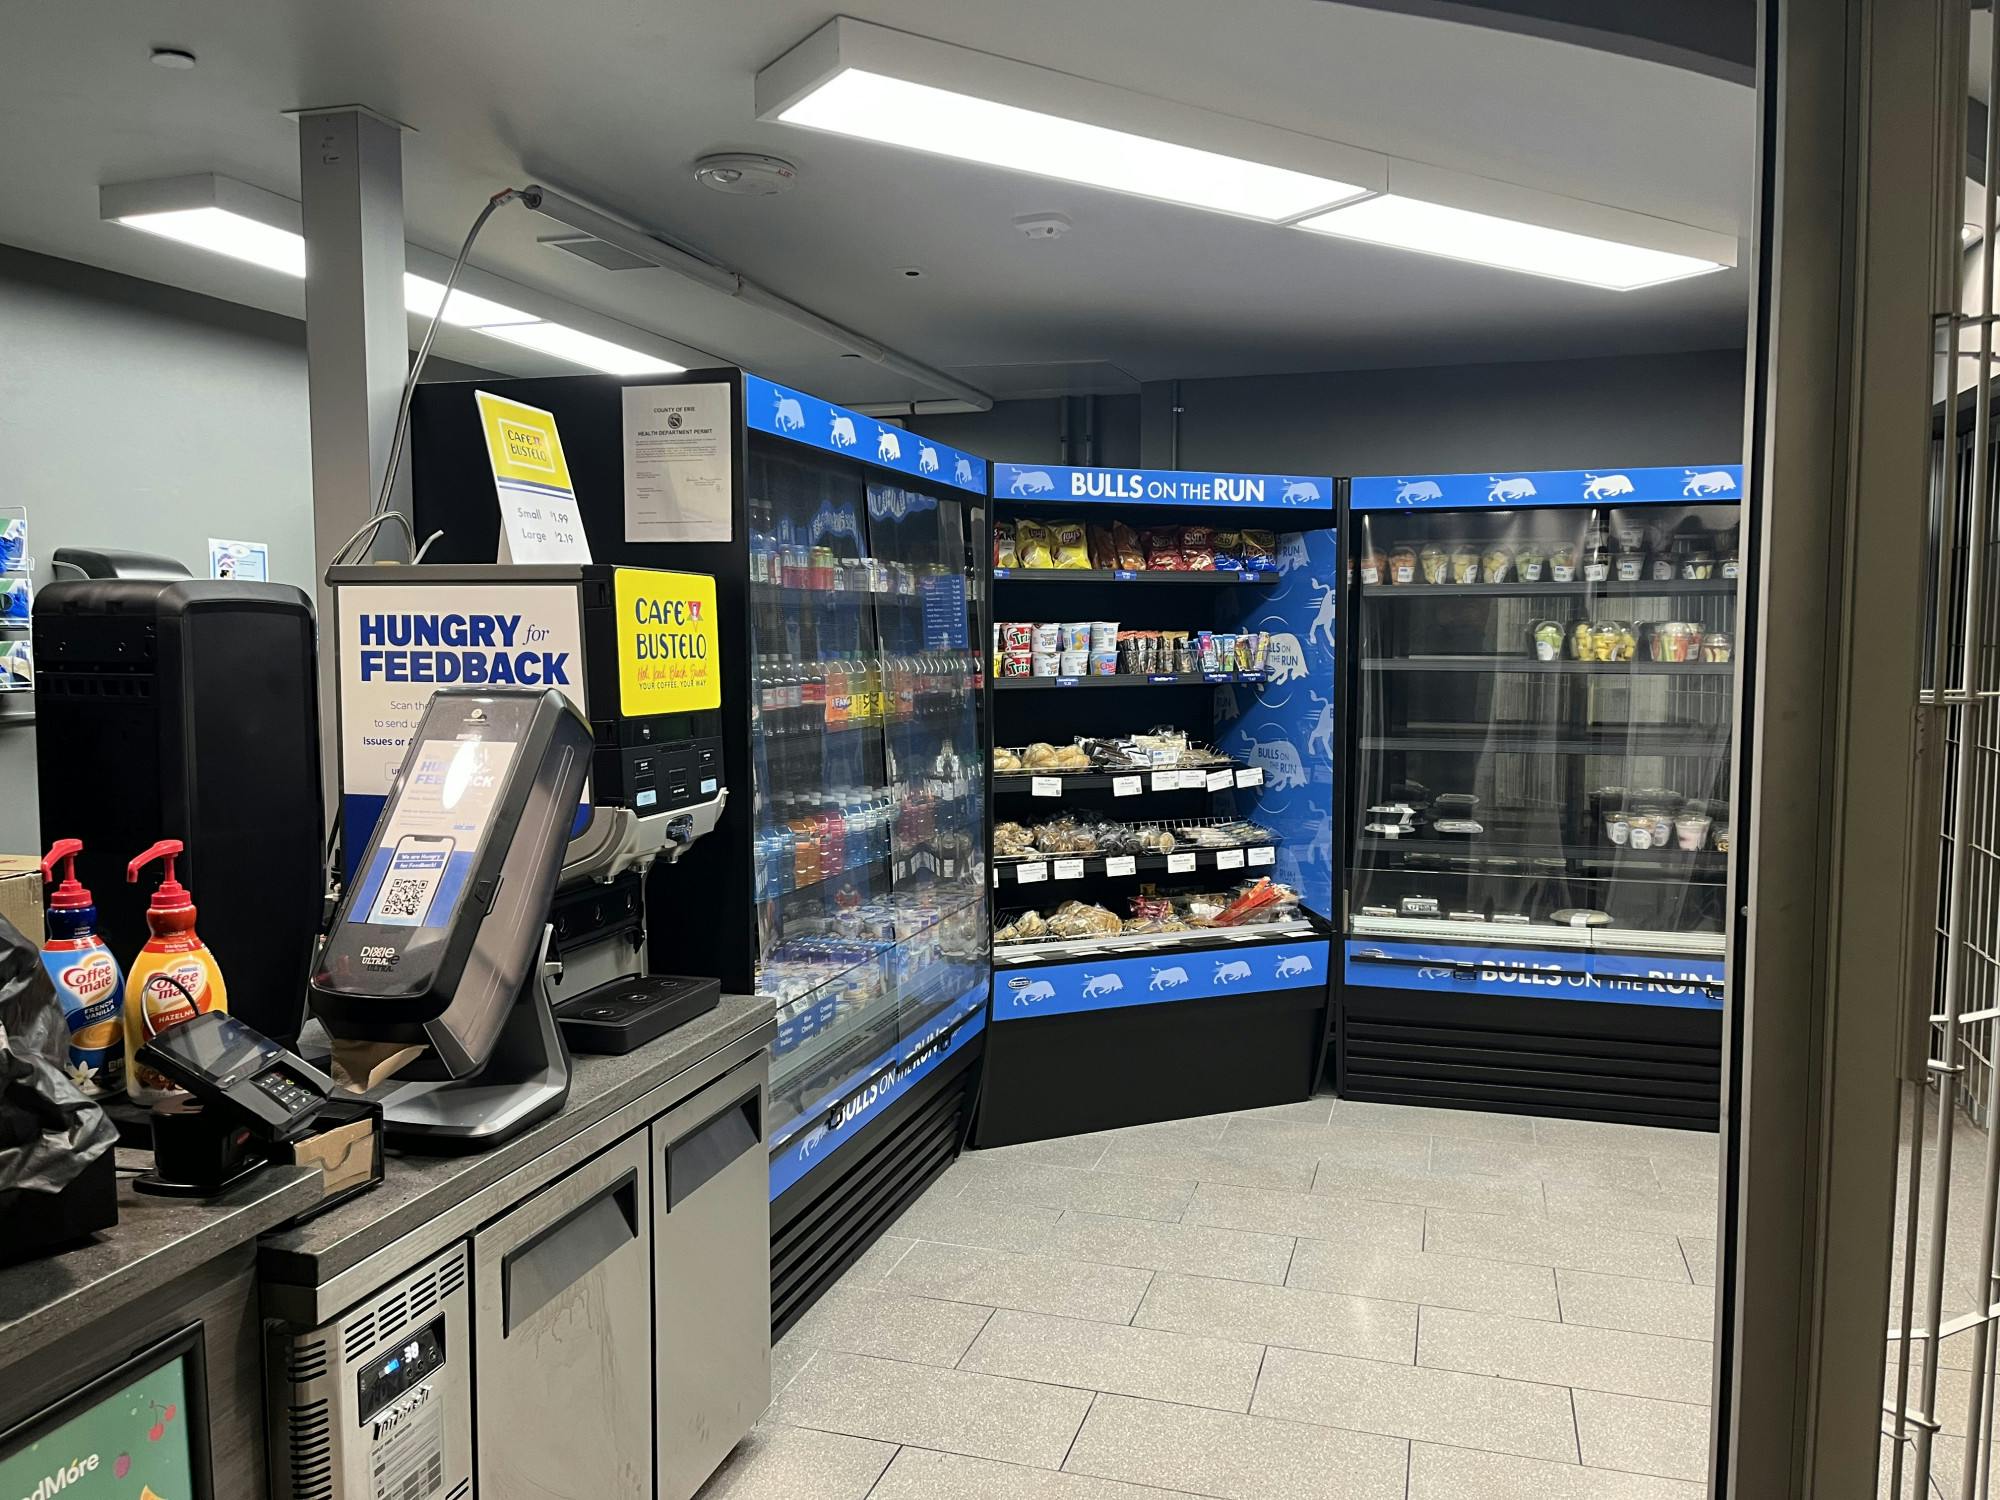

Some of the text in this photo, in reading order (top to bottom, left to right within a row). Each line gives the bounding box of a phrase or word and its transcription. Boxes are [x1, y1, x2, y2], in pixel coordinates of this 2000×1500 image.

[511, 444, 547, 462] BUSTELO
[1071, 472, 1265, 502] BULLS ON THE RUN
[517, 507, 542, 520] Small
[522, 528, 547, 542] Large
[1282, 545, 1300, 558] RUN
[360, 614, 550, 647] HUNGRY for
[636, 633, 707, 660] BUSTELO
[1282, 655, 1298, 666] RUN
[361, 651, 570, 686] FEEDBACK
[1010, 662, 1030, 676] Trix
[639, 682, 656, 690] YOUR
[680, 680, 694, 688] YOUR
[390, 700, 413, 710] Scan
[374, 720, 384, 728] to
[386, 720, 408, 728] send
[364, 736, 405, 746] Issues or
[1258, 747, 1280, 760] BULLS
[1280, 762, 1297, 775] RUN
[63, 965, 111, 987] Coffee
[1482, 960, 1714, 996] BULLS ON THE RUN
[80, 976, 112, 994] mate
[84, 998, 114, 1014] FRENCH
[85, 1005, 115, 1020] VANILLA
[159, 1009, 196, 1024] HAZELNU
[836, 1083, 878, 1130] ULLS
[879, 1066, 896, 1095] ON
